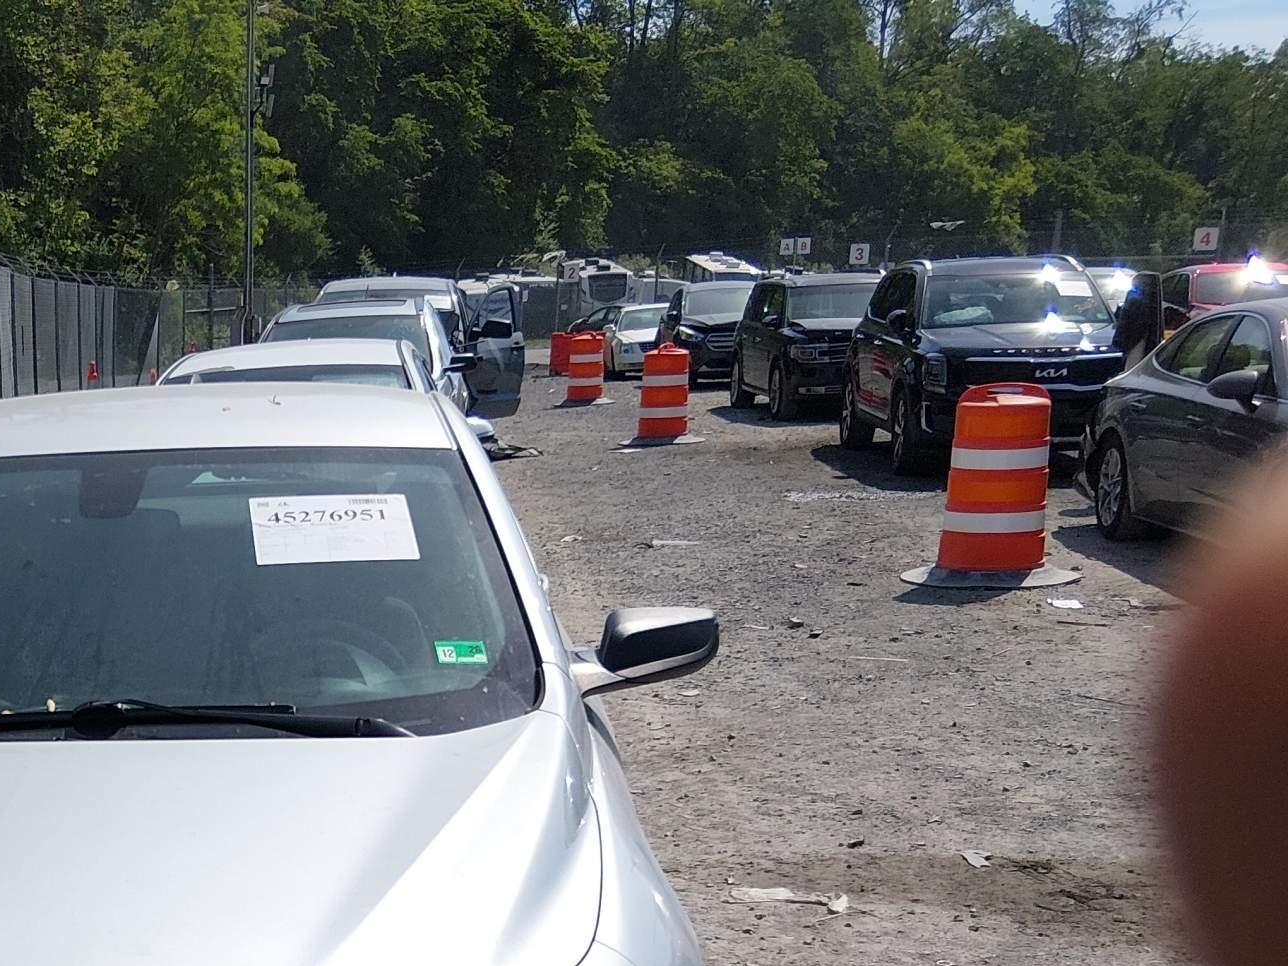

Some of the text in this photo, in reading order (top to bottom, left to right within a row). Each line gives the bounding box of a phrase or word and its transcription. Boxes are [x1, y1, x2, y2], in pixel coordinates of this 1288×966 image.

[1199, 231, 1211, 247] 4
[855, 247, 864, 261] 3
[568, 267, 576, 280] 2
[267, 508, 387, 525] 45276951
[442, 648, 455, 659] 12
